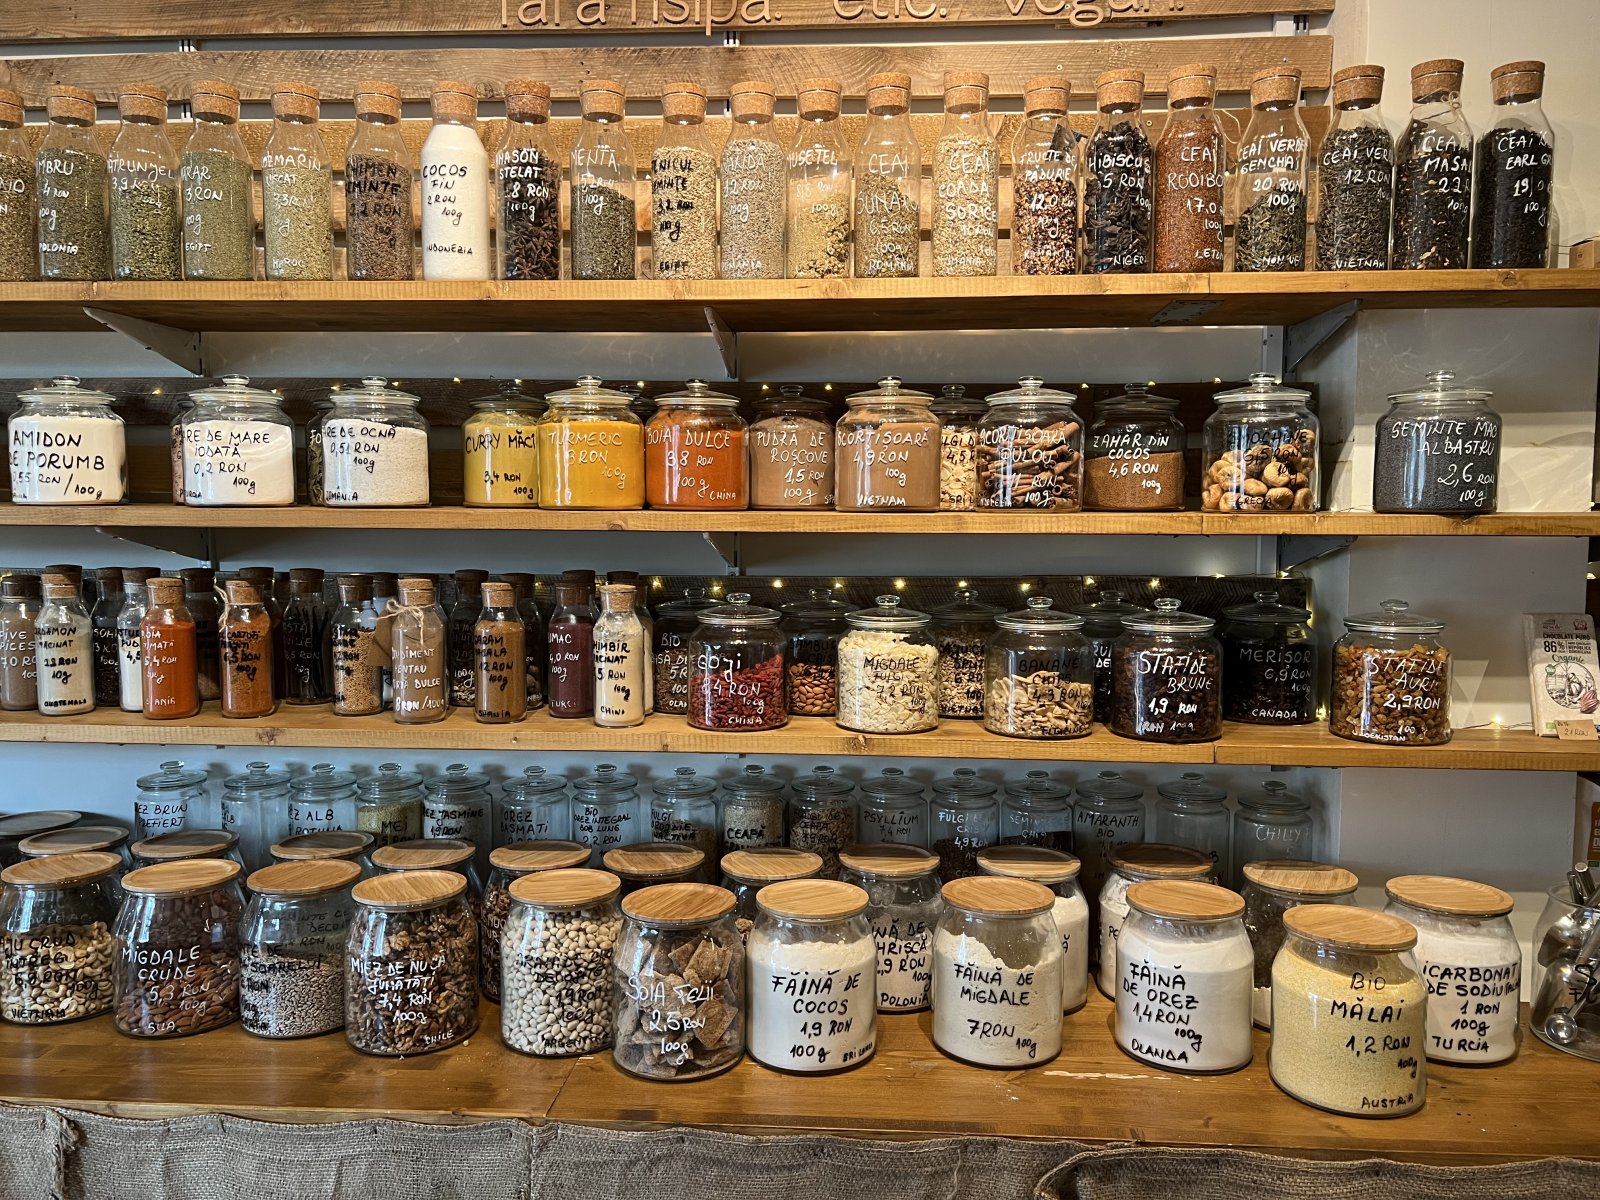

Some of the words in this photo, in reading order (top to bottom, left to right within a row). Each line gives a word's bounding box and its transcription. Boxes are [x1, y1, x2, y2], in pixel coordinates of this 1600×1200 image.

[1505, 154, 1538, 170] EARL
[422, 164, 468, 179] COCOS
[1344, 170, 1360, 185] 12
[1365, 170, 1390, 184] RON
[1103, 174, 1112, 189] 5
[1119, 173, 1144, 189] RON
[1252, 177, 1272, 192] 20
[1279, 178, 1302, 193] RON
[195, 187, 222, 201] RON
[433, 194, 457, 204] RON
[1266, 194, 1296, 214] 100g
[441, 207, 463, 226] 100g
[1524, 202, 1546, 227] 100g
[1335, 258, 1385, 269] VIETNAM
[206, 430, 222, 442] DE
[229, 431, 271, 445] MARE
[340, 427, 356, 438] DE
[361, 425, 398, 439] OCNĂ
[1474, 421, 1498, 439] MAC
[13, 430, 82, 449] AMIDON
[465, 434, 501, 454] CURRY
[685, 430, 731, 449] DULCE
[757, 430, 798, 448] PUDRĂ
[810, 432, 826, 447] DE
[1417, 437, 1495, 457] ALBASTRU
[354, 443, 380, 454] RON
[1108, 448, 1150, 460] COCOS
[1273, 448, 1299, 460] RON
[27, 451, 105, 471] PORUMB
[353, 457, 375, 473] 100g
[579, 450, 608, 464] RON
[697, 455, 714, 467] RON
[878, 450, 909, 464] RON
[193, 464, 213, 477] 0,2
[219, 462, 247, 474] RON
[504, 473, 521, 482] RON
[784, 468, 805, 483] 1,5
[809, 471, 825, 480] RON
[885, 467, 907, 487] 100g
[1108, 462, 1129, 478] 4,6
[1132, 463, 1159, 474] RON
[1437, 463, 1473, 487] 2,6
[1477, 473, 1495, 485] RON
[38, 473, 61, 485] RON
[232, 477, 257, 495] 100g
[1032, 474, 1057, 488] RON
[1141, 479, 1162, 495] 100g
[513, 486, 534, 499] 100g
[1459, 489, 1487, 507] 100g
[491, 662, 513, 672] RON
[1018, 657, 1080, 673] BANANE
[52, 670, 72, 684] 10g
[608, 669, 626, 680] RON
[1291, 668, 1311, 679] RON
[414, 677, 441, 689] DULCE
[729, 682, 761, 698] RON
[901, 684, 924, 696] RON
[1167, 676, 1213, 693] BRUNE
[613, 684, 631, 700] 100g
[1148, 698, 1168, 715] 1,9
[1178, 702, 1197, 713] RON
[1383, 693, 1412, 709] 2,9
[1414, 697, 1441, 710] RON
[1252, 708, 1298, 719] CANADA
[154, 803, 187, 814] BRUN
[306, 809, 334, 821] ALB
[504, 810, 532, 823] OREZ
[1077, 811, 1139, 827] AMARANTH
[727, 824, 765, 840] CEAPĂ
[906, 921, 925, 936] DE
[122, 945, 201, 965] MIGDALE
[138, 965, 196, 981] CRUDE
[388, 962, 405, 975] DE
[900, 958, 926, 972] RON
[844, 972, 862, 990] DE
[912, 970, 932, 990] 100g
[1016, 972, 1035, 986] DE
[1123, 977, 1138, 996] DE
[1147, 988, 1199, 1010] OREZ
[1427, 979, 1448, 996] DE
[378, 995, 402, 1011] 7,4
[409, 995, 432, 1007] RON
[793, 999, 849, 1015] COCOS
[881, 992, 929, 1007] POLONIA
[1460, 999, 1469, 1014] 1
[1475, 1002, 1501, 1014] RON
[179, 1000, 207, 1017] 100g
[1132, 1002, 1152, 1023] 1,4
[1155, 1009, 1190, 1026] RON
[393, 1011, 427, 1024] 100g
[649, 1010, 680, 1033] 2,5
[683, 1017, 706, 1030] RON
[800, 1021, 822, 1039] 1,9
[829, 1017, 853, 1034] RON
[967, 1019, 979, 1034] 7
[980, 1022, 1015, 1038] RON
[1450, 1018, 1490, 1037] 100g
[1016, 1038, 1037, 1057] 100g
[1174, 1027, 1203, 1052] 100g
[1345, 1036, 1377, 1057] 1,2
[1382, 1036, 1411, 1051] RON
[661, 1038, 689, 1066] 100g
[790, 1043, 830, 1063] 100g
[1131, 1038, 1189, 1064] OLANDA
[1397, 1057, 1418, 1079] 100g
